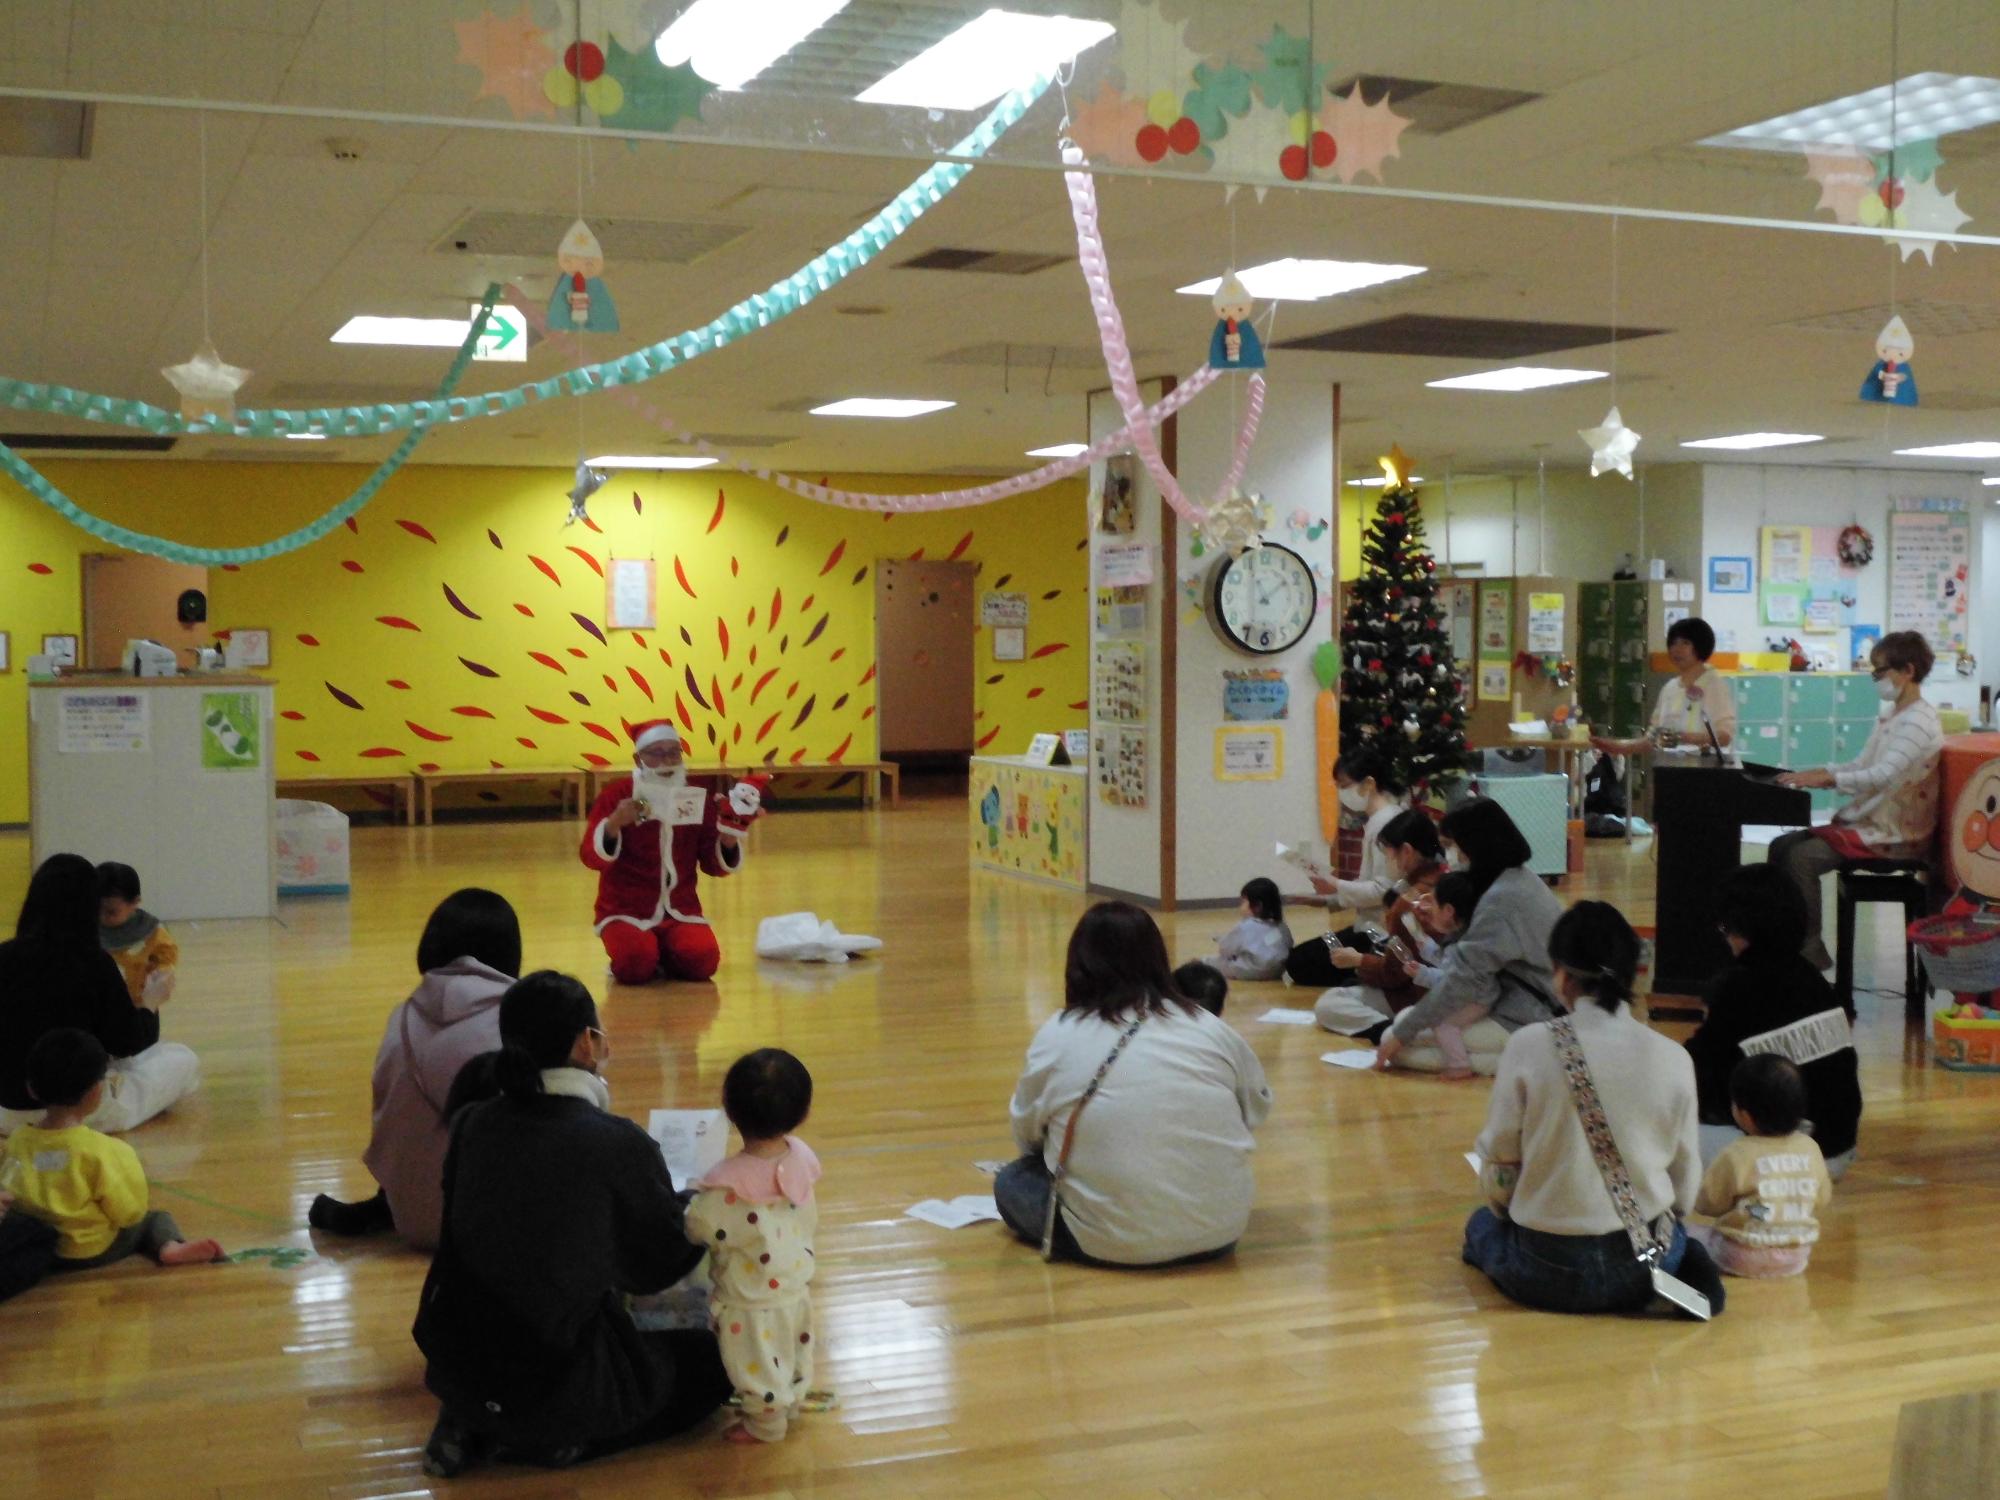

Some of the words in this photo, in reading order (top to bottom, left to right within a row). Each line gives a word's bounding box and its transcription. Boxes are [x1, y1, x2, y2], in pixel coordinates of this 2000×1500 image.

[1291, 570, 1301, 586] 2
[1224, 591, 1234, 605] 9
[1228, 610, 1239, 626] 8
[1242, 626, 1251, 643] 7
[1259, 631, 1271, 647] 6
[1280, 626, 1288, 641] 5
[1756, 1153, 1809, 1173] EVERY
